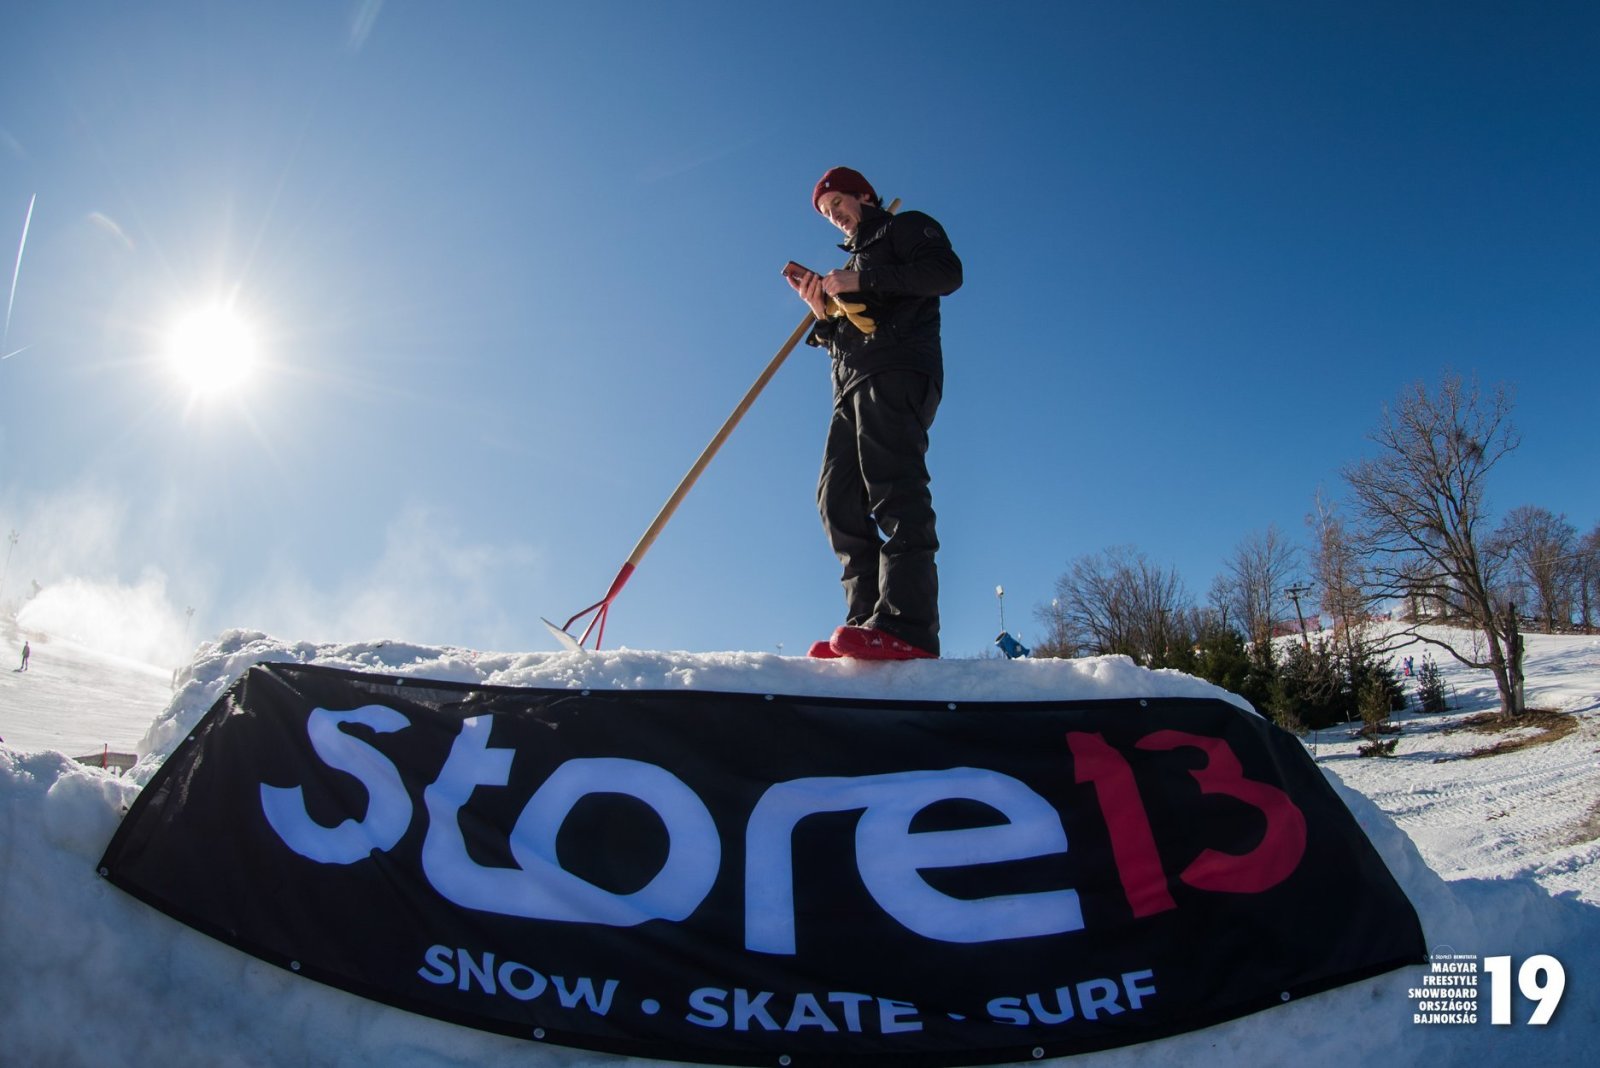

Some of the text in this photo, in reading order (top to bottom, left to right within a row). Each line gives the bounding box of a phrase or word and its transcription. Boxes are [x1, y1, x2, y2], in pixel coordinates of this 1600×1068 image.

[418, 945, 1156, 1034] SNOW SKATE SURF
